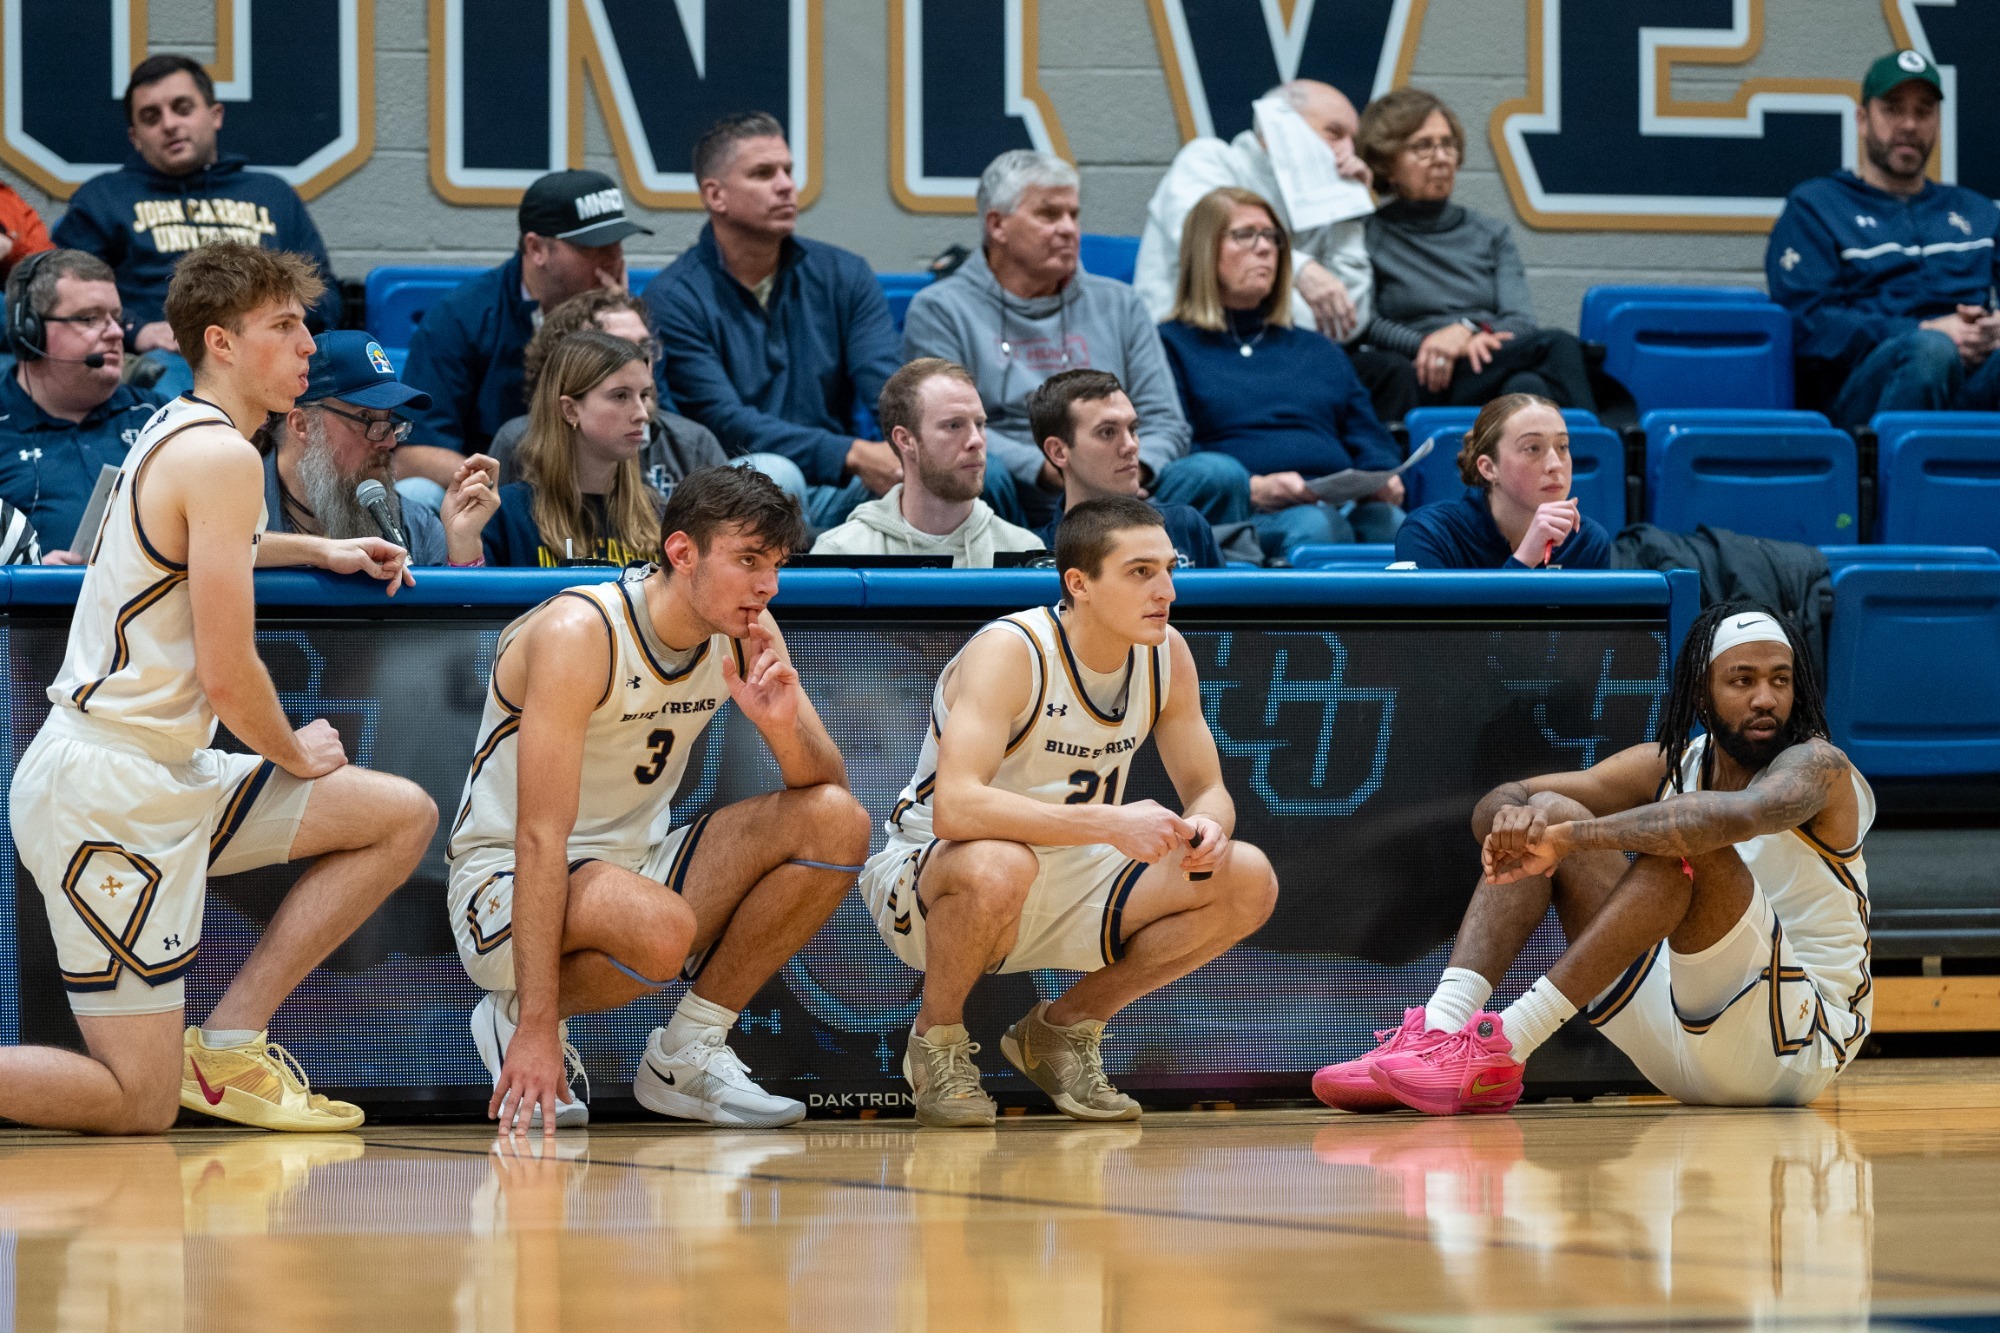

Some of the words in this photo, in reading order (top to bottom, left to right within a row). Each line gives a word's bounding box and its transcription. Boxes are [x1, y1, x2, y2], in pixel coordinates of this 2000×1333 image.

[133, 199, 186, 233] JOHN
[186, 198, 276, 236] CARROLL
[661, 698, 716, 714] TREAKS
[633, 728, 676, 785] 3
[1045, 740, 1091, 758] BLUE
[1092, 737, 1137, 759] SREA
[1064, 766, 1120, 805] 21
